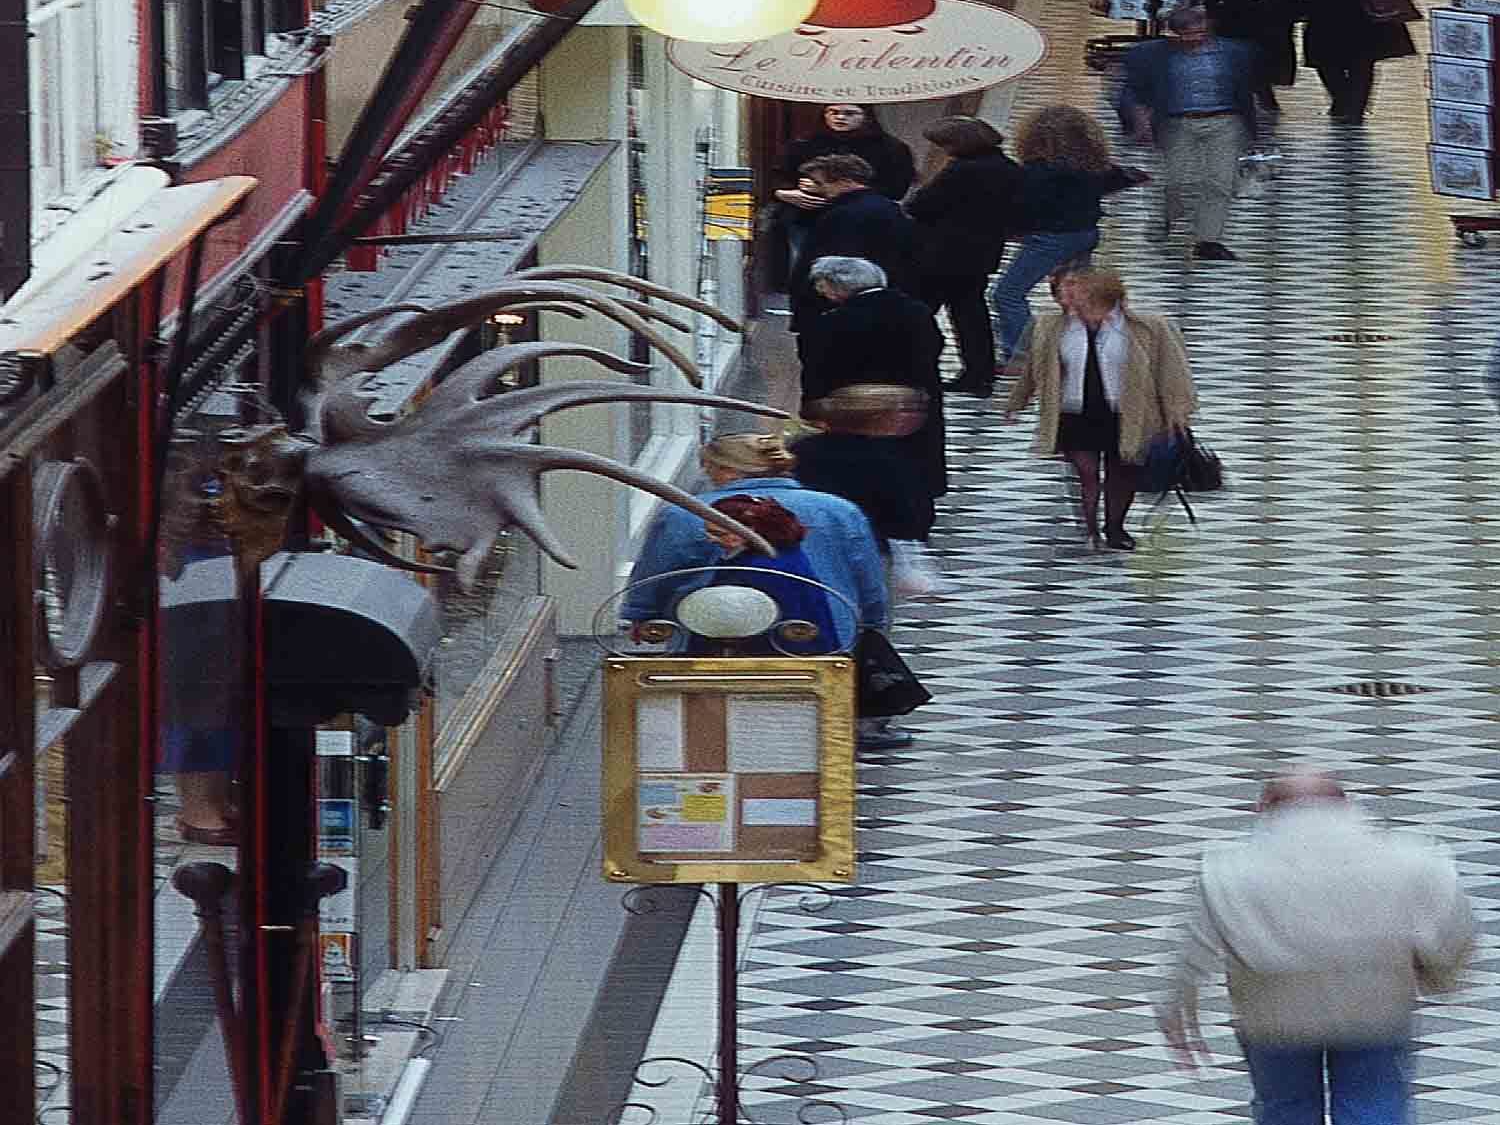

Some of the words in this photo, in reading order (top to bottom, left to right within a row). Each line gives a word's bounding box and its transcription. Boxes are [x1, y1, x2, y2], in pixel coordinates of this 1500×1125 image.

[708, 40, 780, 73] Le
[788, 38, 1014, 74] Valentin
[739, 74, 827, 98] Cuisine
[831, 84, 857, 98] et
